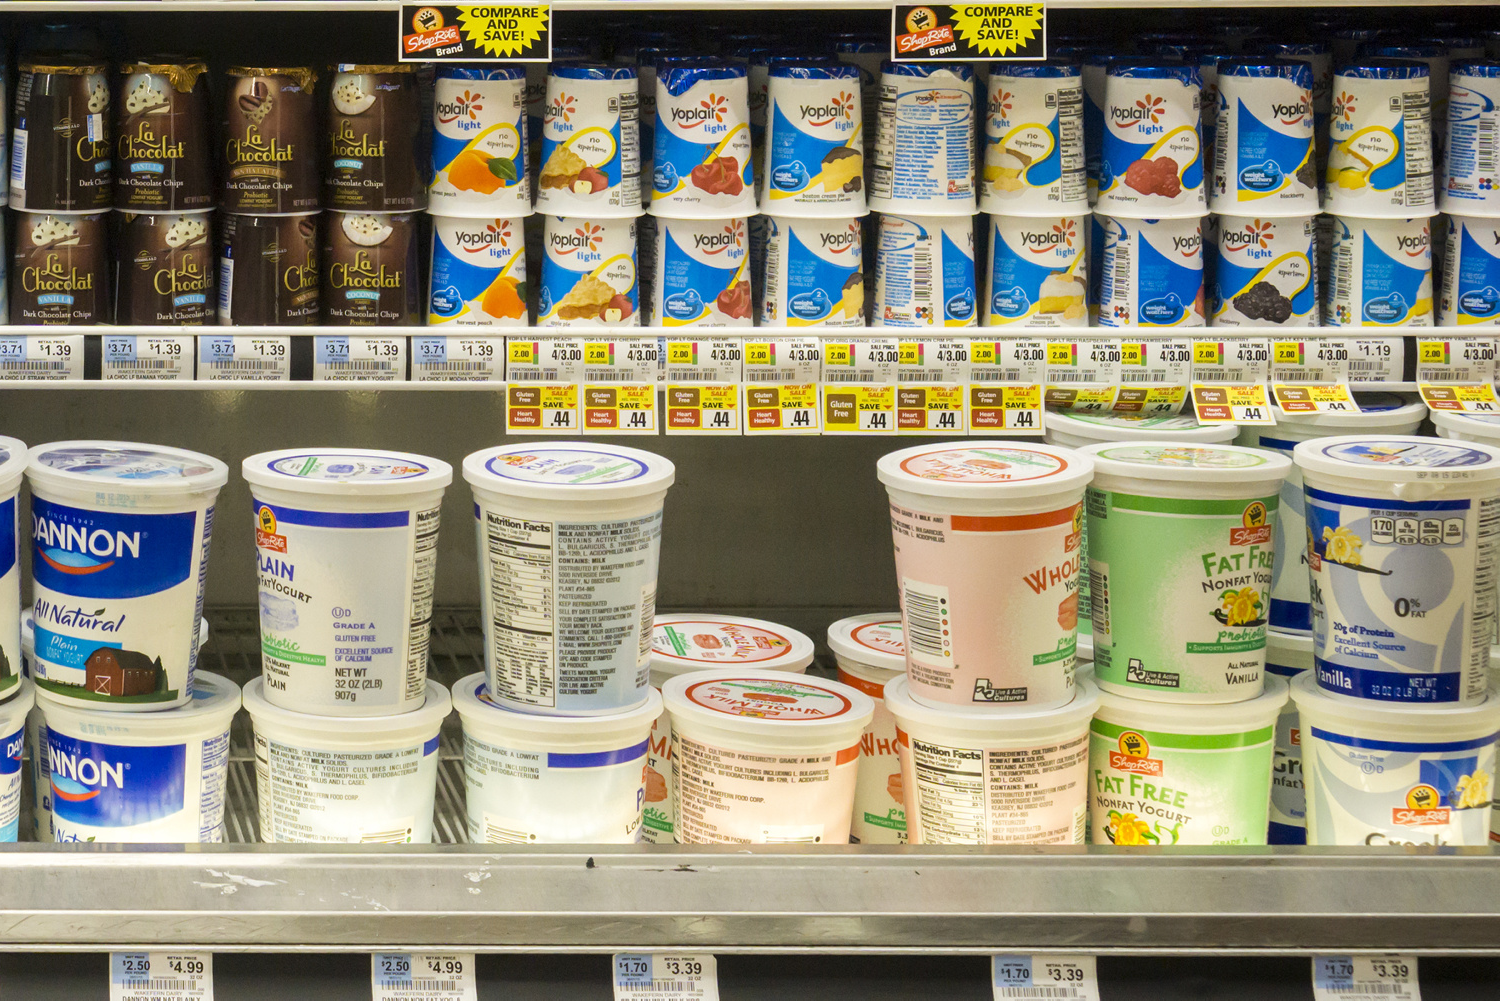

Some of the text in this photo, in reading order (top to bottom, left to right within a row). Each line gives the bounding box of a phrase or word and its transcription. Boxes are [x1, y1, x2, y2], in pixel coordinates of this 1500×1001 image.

[471, 8, 538, 17] COMPARE
[964, 6, 1033, 16] COMPARE
[487, 20, 518, 29] AND
[980, 18, 1012, 28] AND
[408, 28, 456, 51] ShopRite
[483, 31, 524, 40] SAVE!
[901, 28, 949, 50] ShopRite
[977, 30, 1018, 39] SAVE!
[436, 43, 463, 56] Brand
[929, 43, 956, 56] Brand
[671, 106, 716, 122] Yoplait
[704, 123, 727, 133] light
[456, 229, 503, 245] Yoplait
[490, 247, 511, 258] light
[40, 343, 72, 357] $1.39
[552, 350, 581, 361] 4/3.00
[551, 411, 569, 426] .44
[335, 680, 382, 689] 32 OZ (2LB)
[1226, 671, 1259, 686] VANILLA
[1096, 769, 1188, 809] FAT FREE
[1098, 797, 1191, 825] NONFAT YOGURT
[1373, 964, 1408, 977] $3.39
